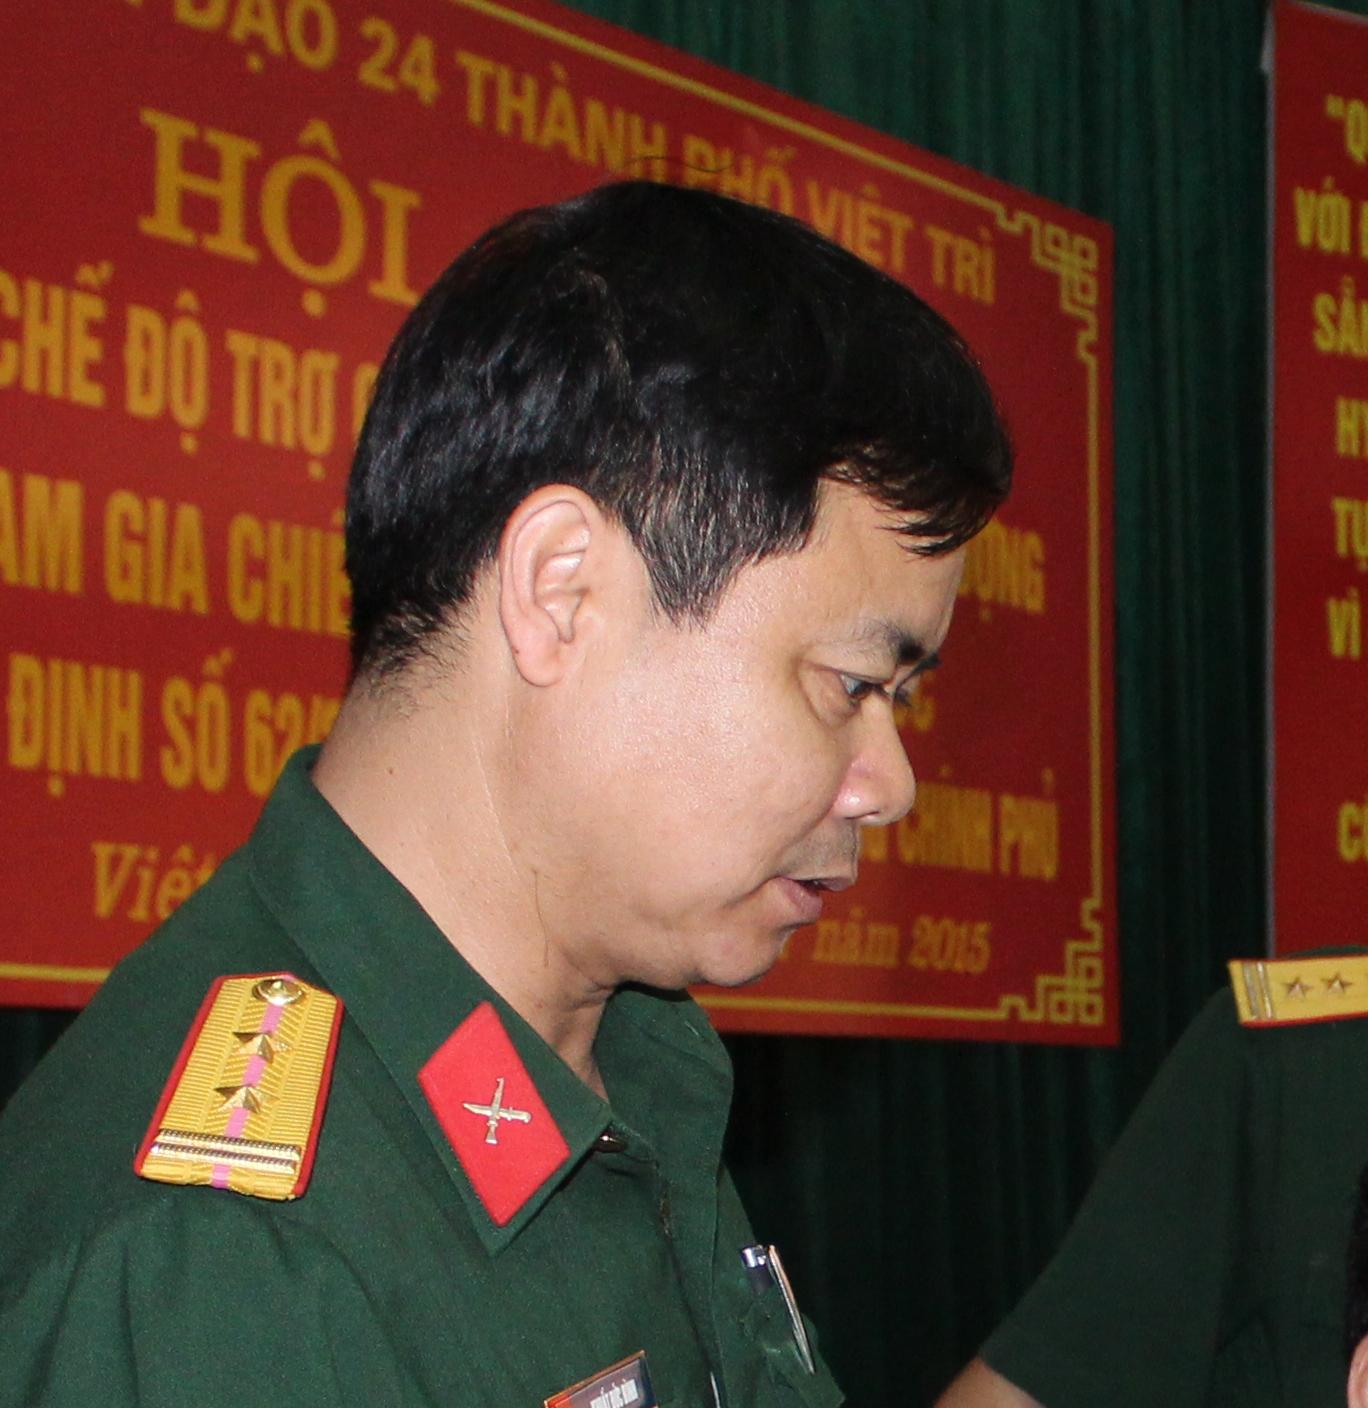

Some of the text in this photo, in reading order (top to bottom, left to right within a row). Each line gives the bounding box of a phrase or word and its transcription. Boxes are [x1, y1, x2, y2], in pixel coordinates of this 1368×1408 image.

[139, 107, 421, 318] HỘI
[358, 17, 441, 105] 24
[455, 49, 666, 183] THÀNH
[926, 227, 995, 304] TRÌ
[1294, 176, 1351, 255] VỚI
[125, 289, 209, 455] ĐỘ
[226, 330, 340, 480] TRỢ
[104, 489, 208, 615] GIA
[1327, 588, 1361, 660] VÌ
[7, 652, 142, 797] ĐỊNH
[161, 648, 233, 792] SỐ
[908, 914, 993, 975] 2015
